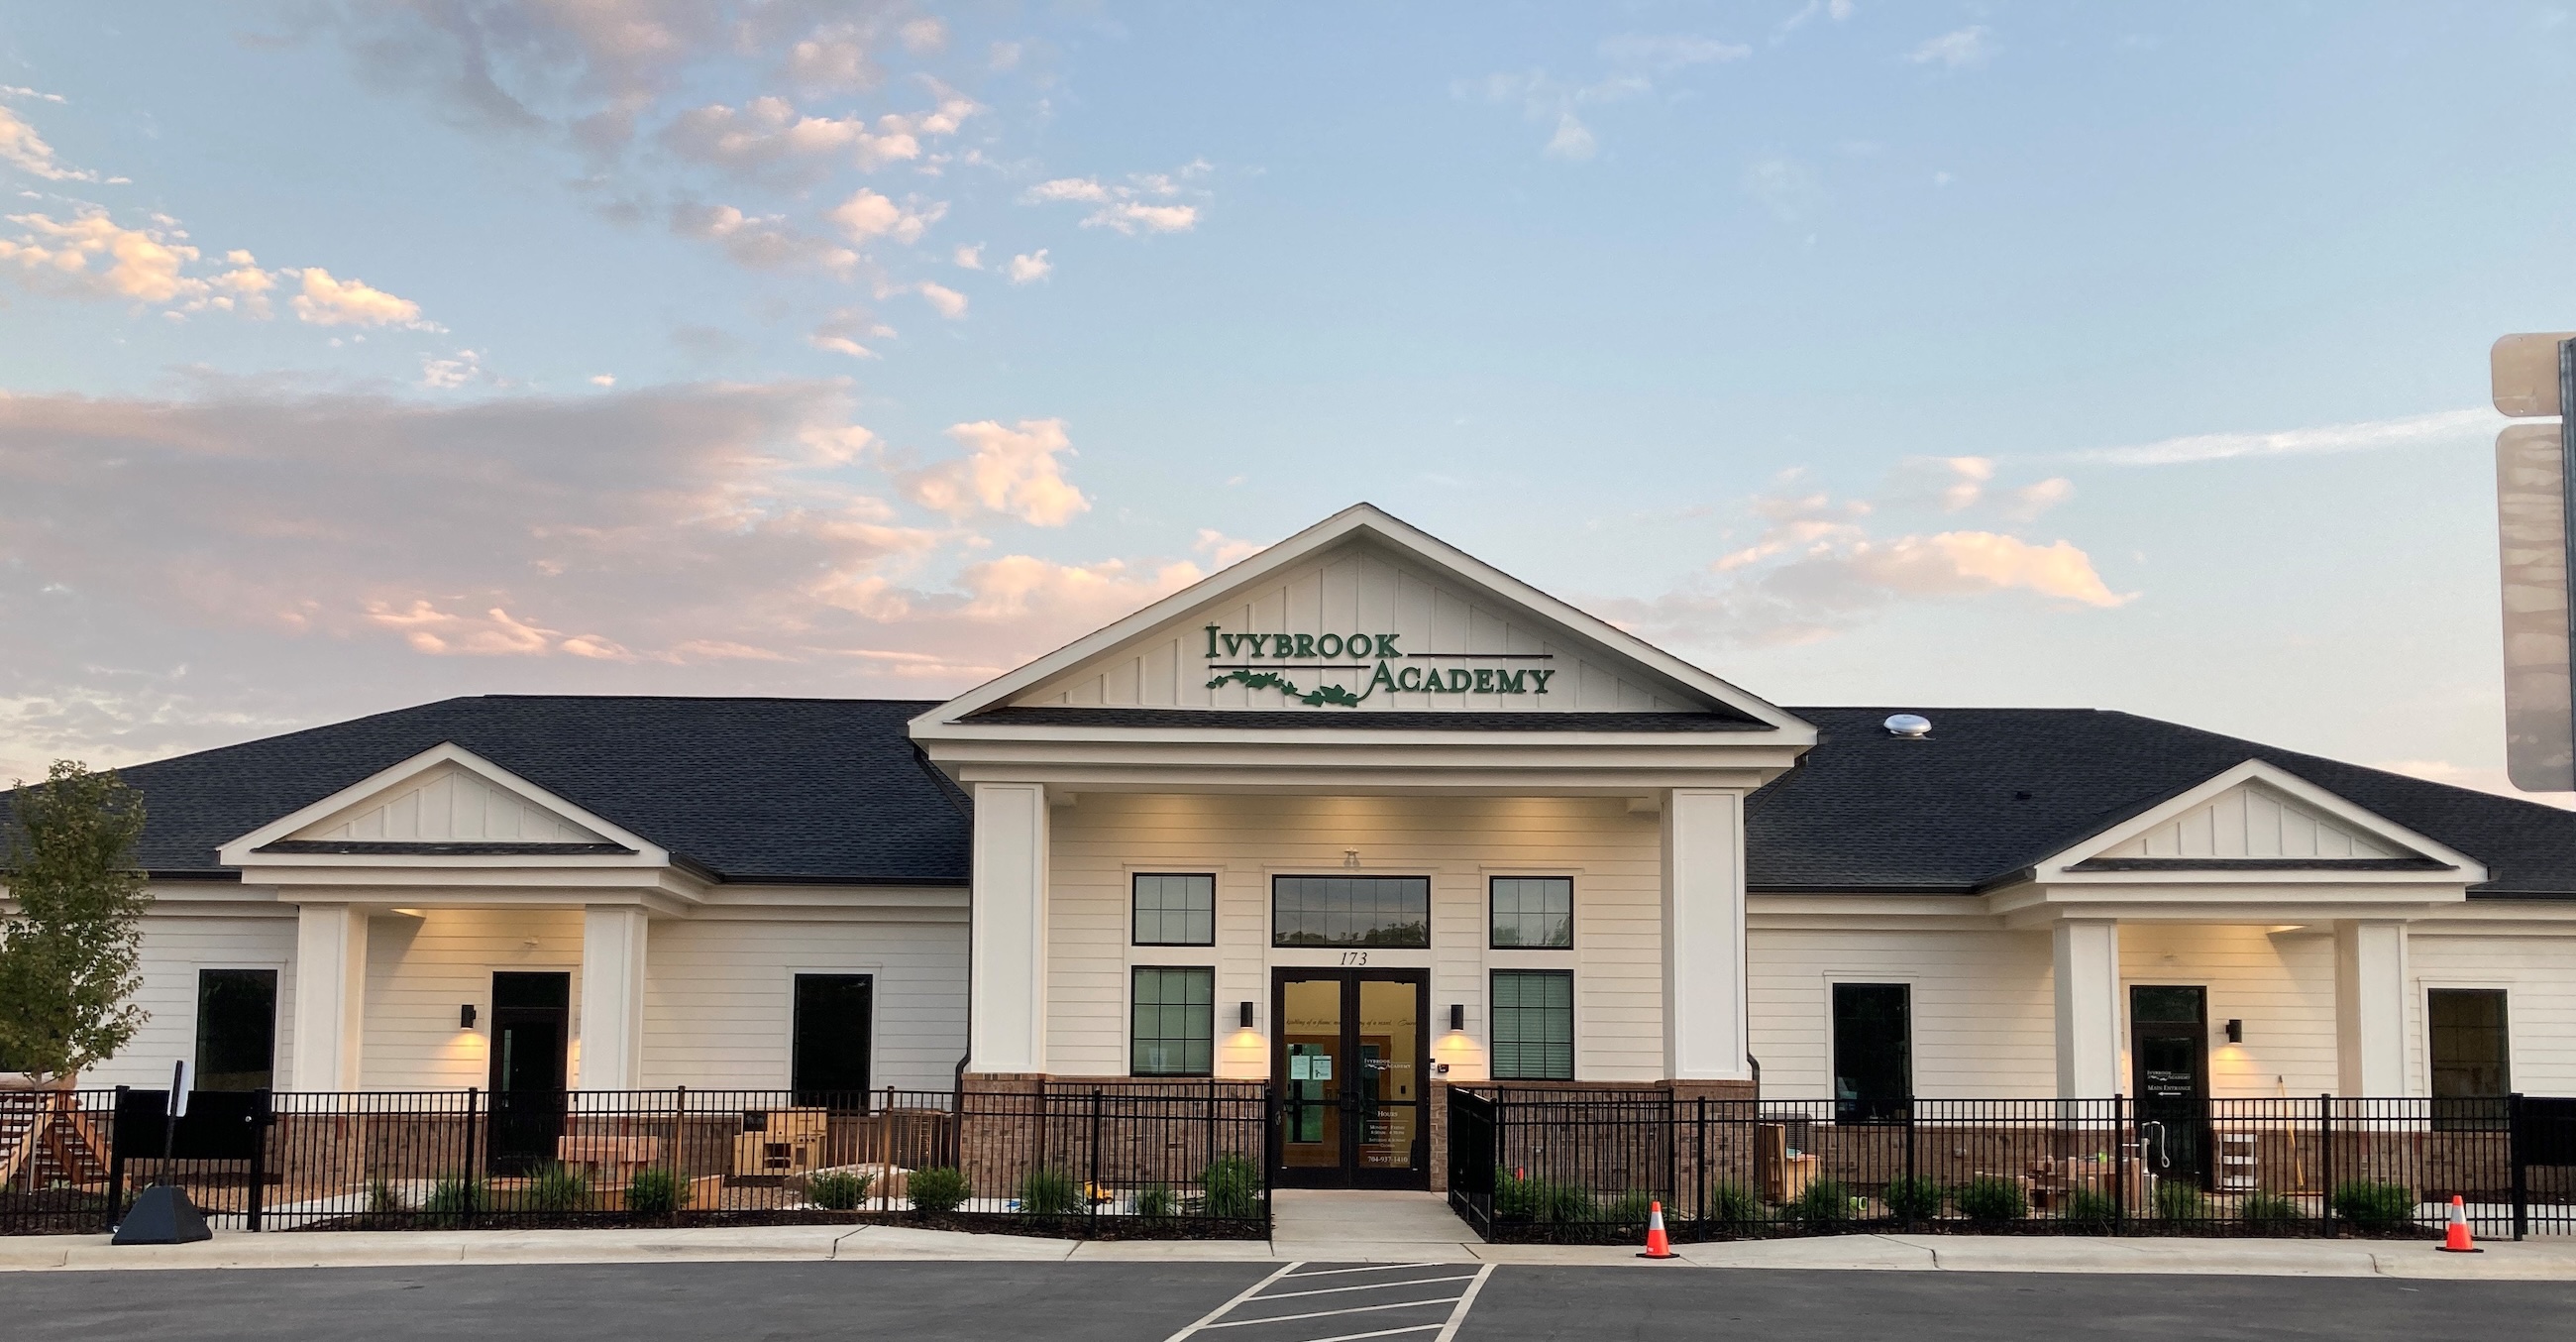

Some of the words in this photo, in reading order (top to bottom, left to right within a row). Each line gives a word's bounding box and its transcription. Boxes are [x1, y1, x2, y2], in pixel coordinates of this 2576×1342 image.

[1205, 625, 1402, 658] IVYBROOK
[1367, 660, 1556, 694] ACADEMY
[1340, 951, 1368, 966] 173
